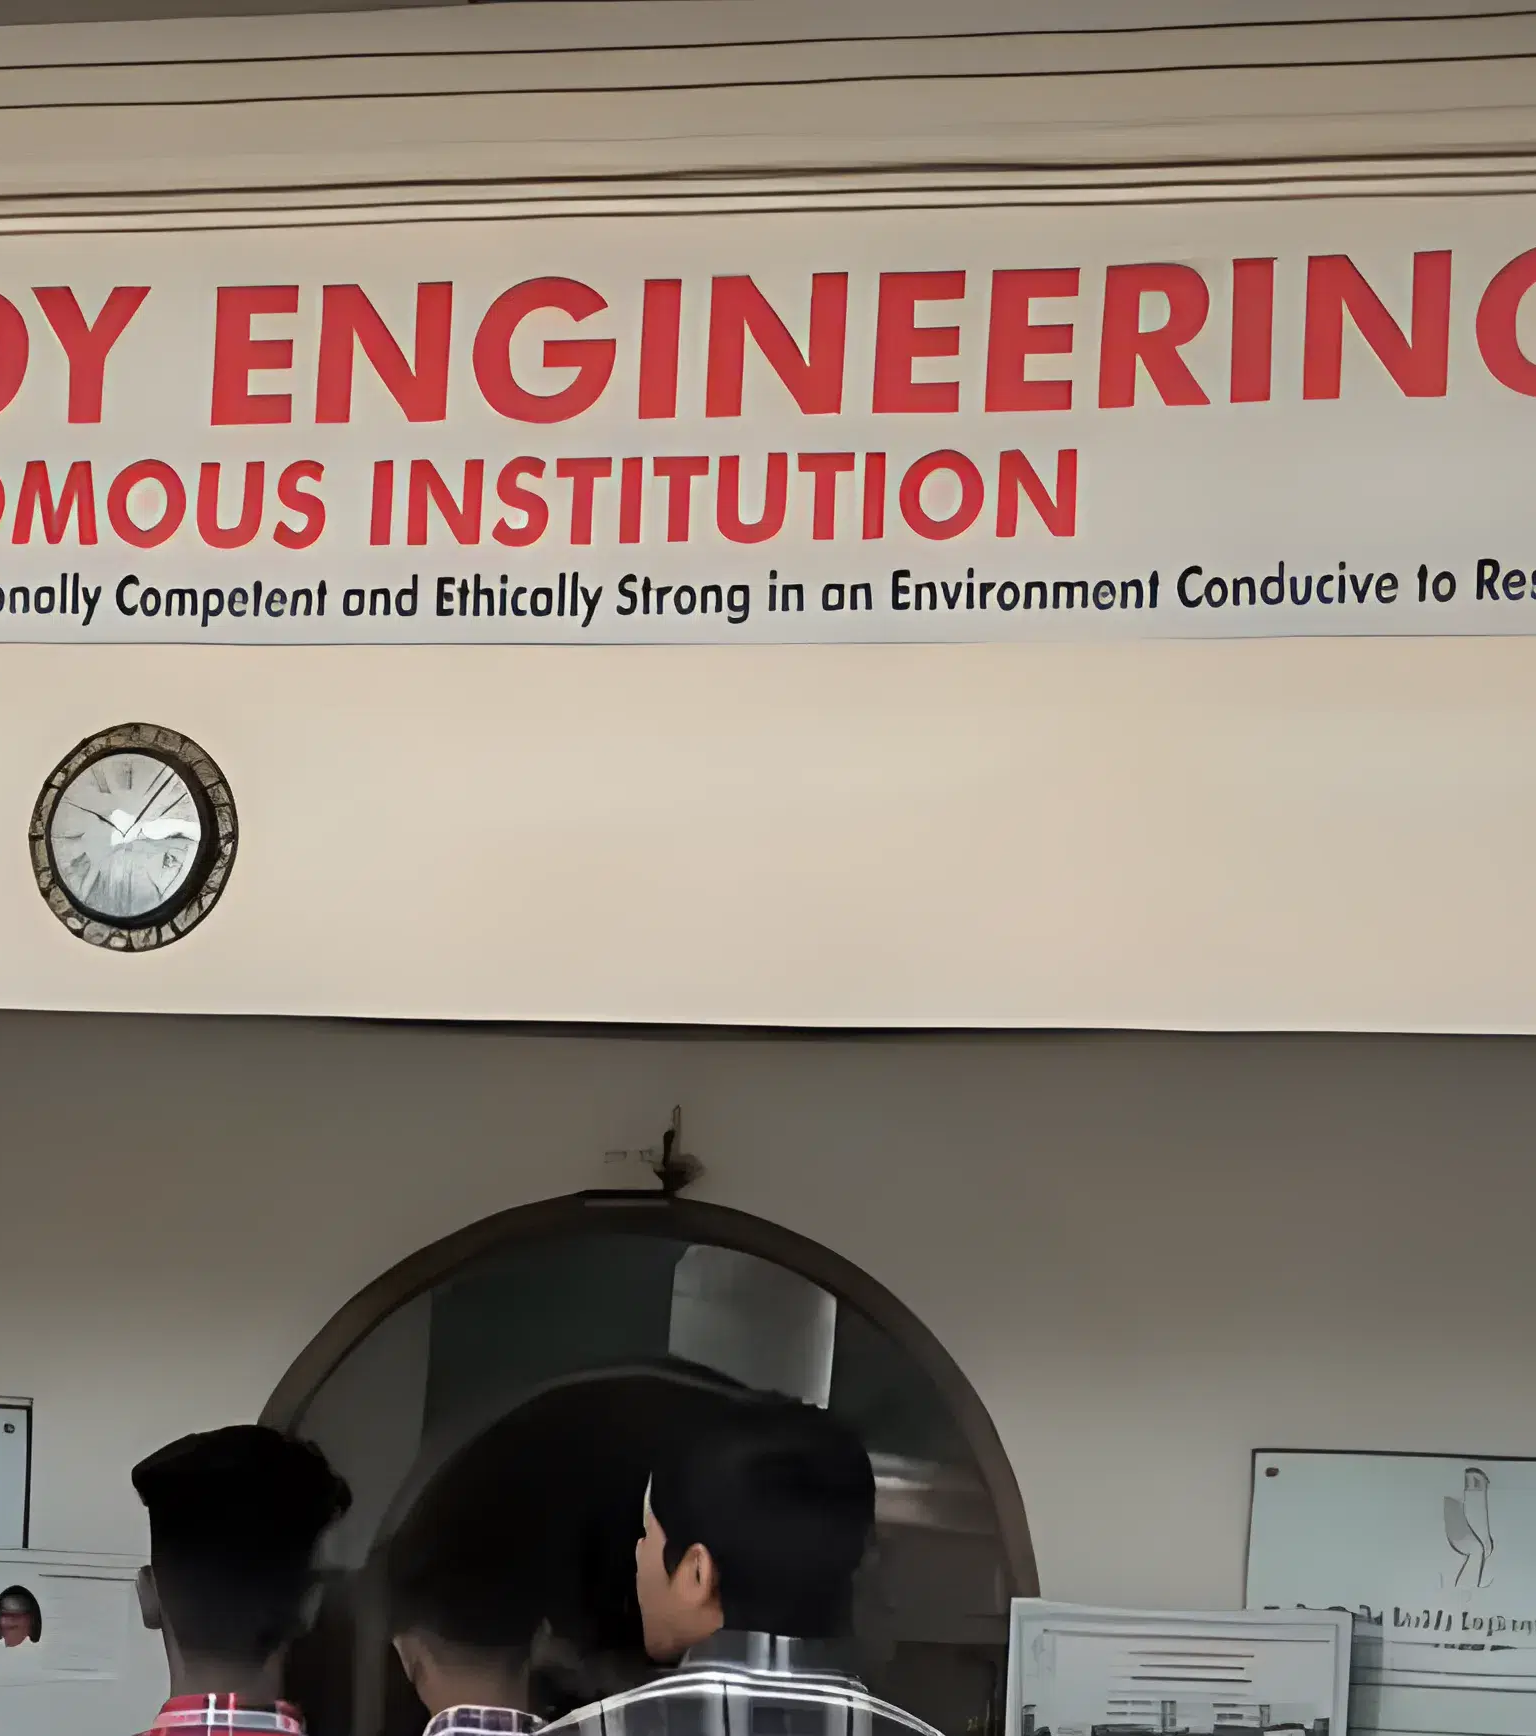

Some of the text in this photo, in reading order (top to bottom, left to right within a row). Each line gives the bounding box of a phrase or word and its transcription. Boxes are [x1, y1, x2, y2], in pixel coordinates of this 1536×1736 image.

[370, 449, 1077, 550] INSTITUTION
[116, 575, 327, 627] Competent
[343, 574, 418, 616] and
[436, 572, 602, 627] Ethically
[617, 574, 749, 624] Strong
[769, 570, 803, 611] in
[822, 583, 872, 611] an
[892, 568, 1159, 611] Environment
[1177, 561, 1398, 608] Conducive
[1417, 564, 1456, 602] to
